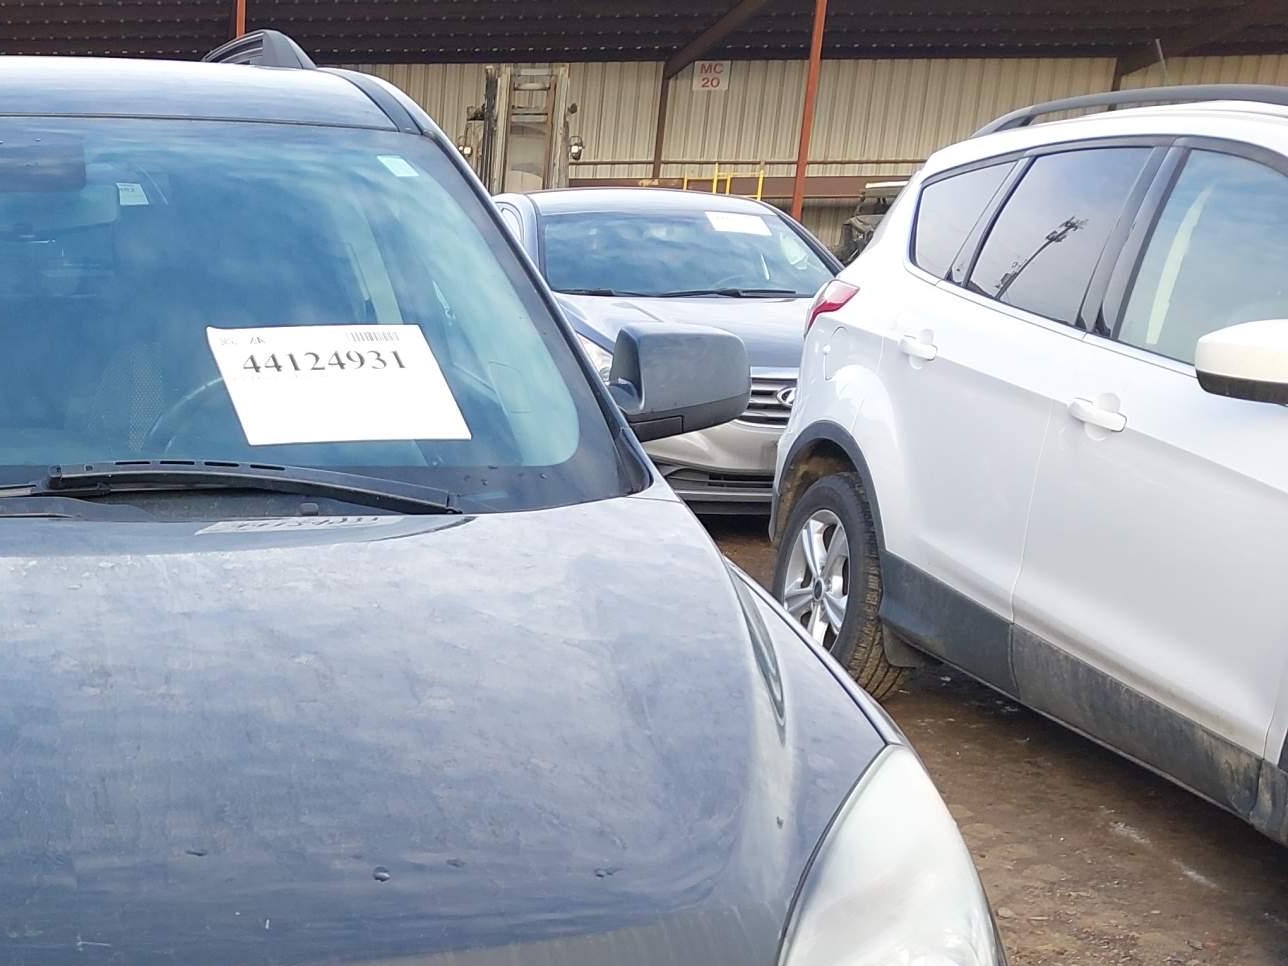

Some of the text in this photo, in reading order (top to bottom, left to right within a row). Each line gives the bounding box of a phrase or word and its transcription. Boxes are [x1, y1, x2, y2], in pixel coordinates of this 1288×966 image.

[700, 63, 724, 74] MC
[702, 77, 721, 88] 20
[243, 350, 406, 373] 44124931
